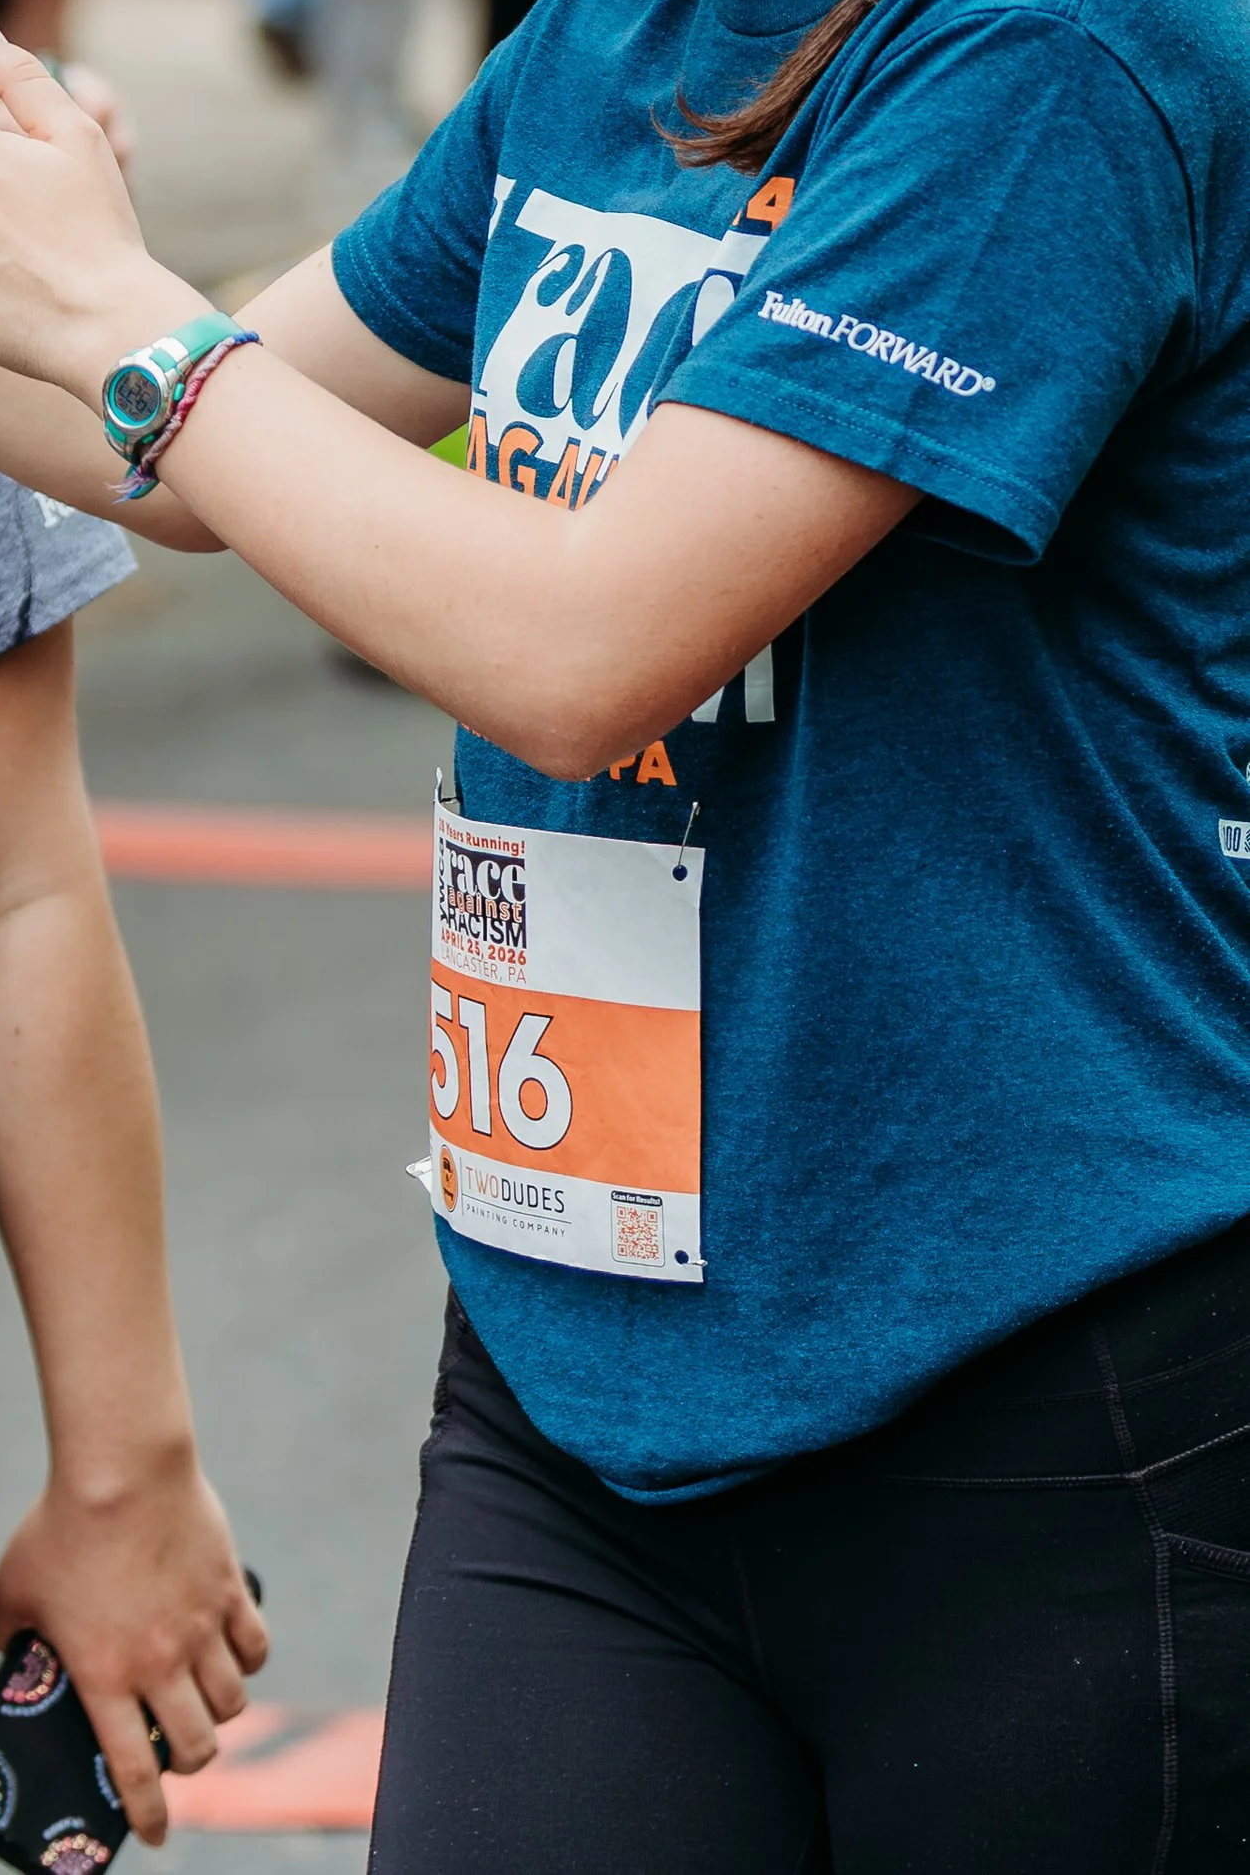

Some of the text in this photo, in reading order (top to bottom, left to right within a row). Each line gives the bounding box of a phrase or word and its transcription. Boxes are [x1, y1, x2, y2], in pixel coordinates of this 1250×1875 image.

[446, 823, 464, 844] Years
[466, 832, 526, 857] Running!
[445, 847, 527, 905] race
[448, 886, 523, 923] against
[441, 926, 465, 952] APRIL
[488, 944, 527, 966] 2026
[447, 907, 527, 950] RACISM
[441, 945, 527, 984] LANCASTER, PA
[466, 1203, 566, 1238] PAINTING COMPANY
